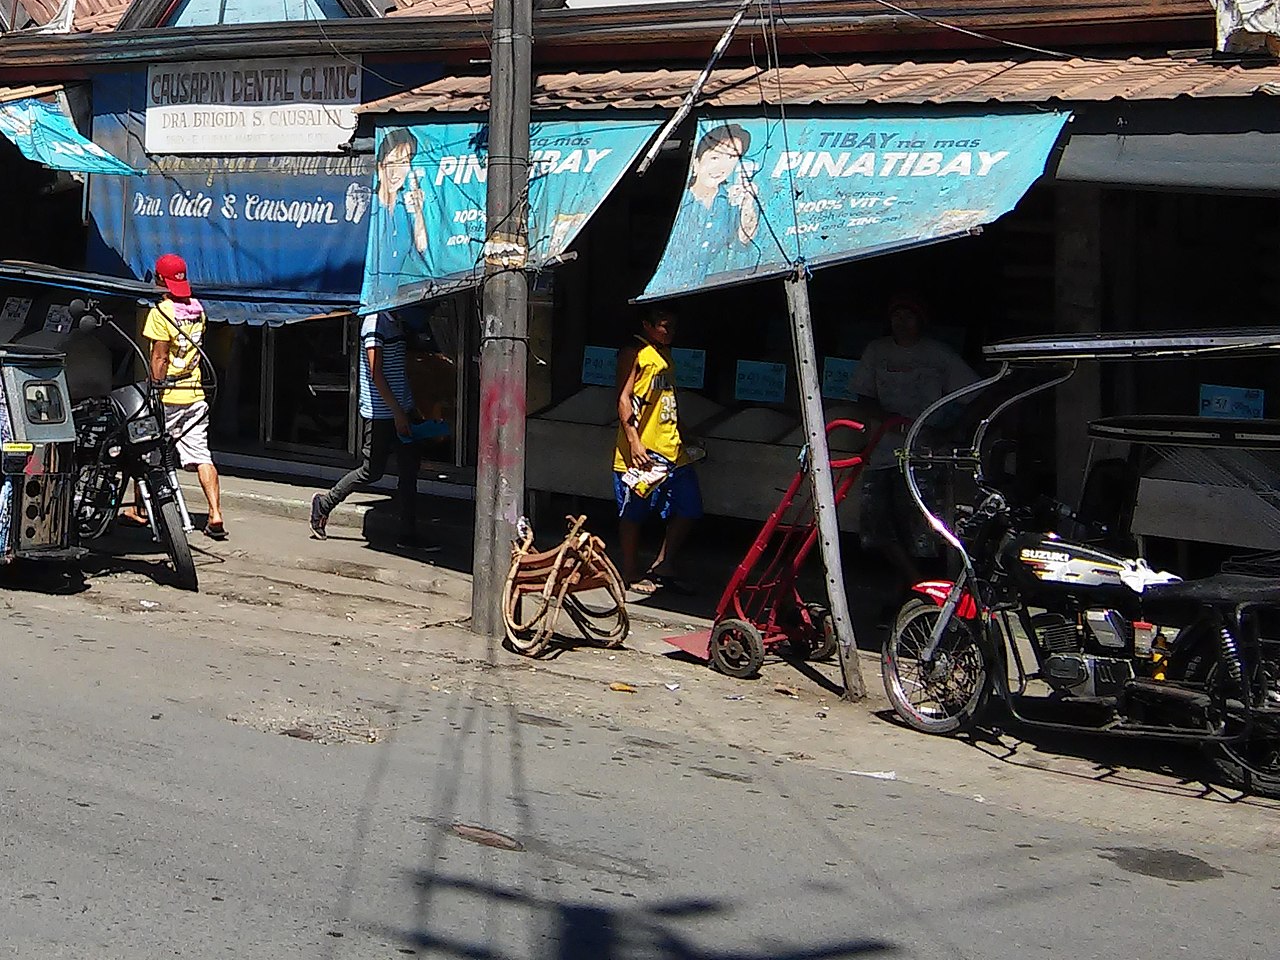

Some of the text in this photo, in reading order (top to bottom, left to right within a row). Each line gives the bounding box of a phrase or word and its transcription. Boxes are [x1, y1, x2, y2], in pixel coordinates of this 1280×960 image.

[150, 65, 359, 105] CAUSAPIN DENTAL CLINIC
[162, 111, 190, 130] DRA.
[193, 110, 246, 129] BRIGIDA
[252, 109, 265, 127] S.
[819, 131, 981, 150] TIBAY na mas
[435, 148, 613, 187] PINIBAY
[771, 151, 1009, 178] PINATIBAY
[244, 193, 339, 230] Causapin
[849, 197, 880, 209] VIT
[882, 195, 898, 207] C
[846, 216, 881, 228] ZINC
[1022, 549, 1070, 563] SUZUKI
